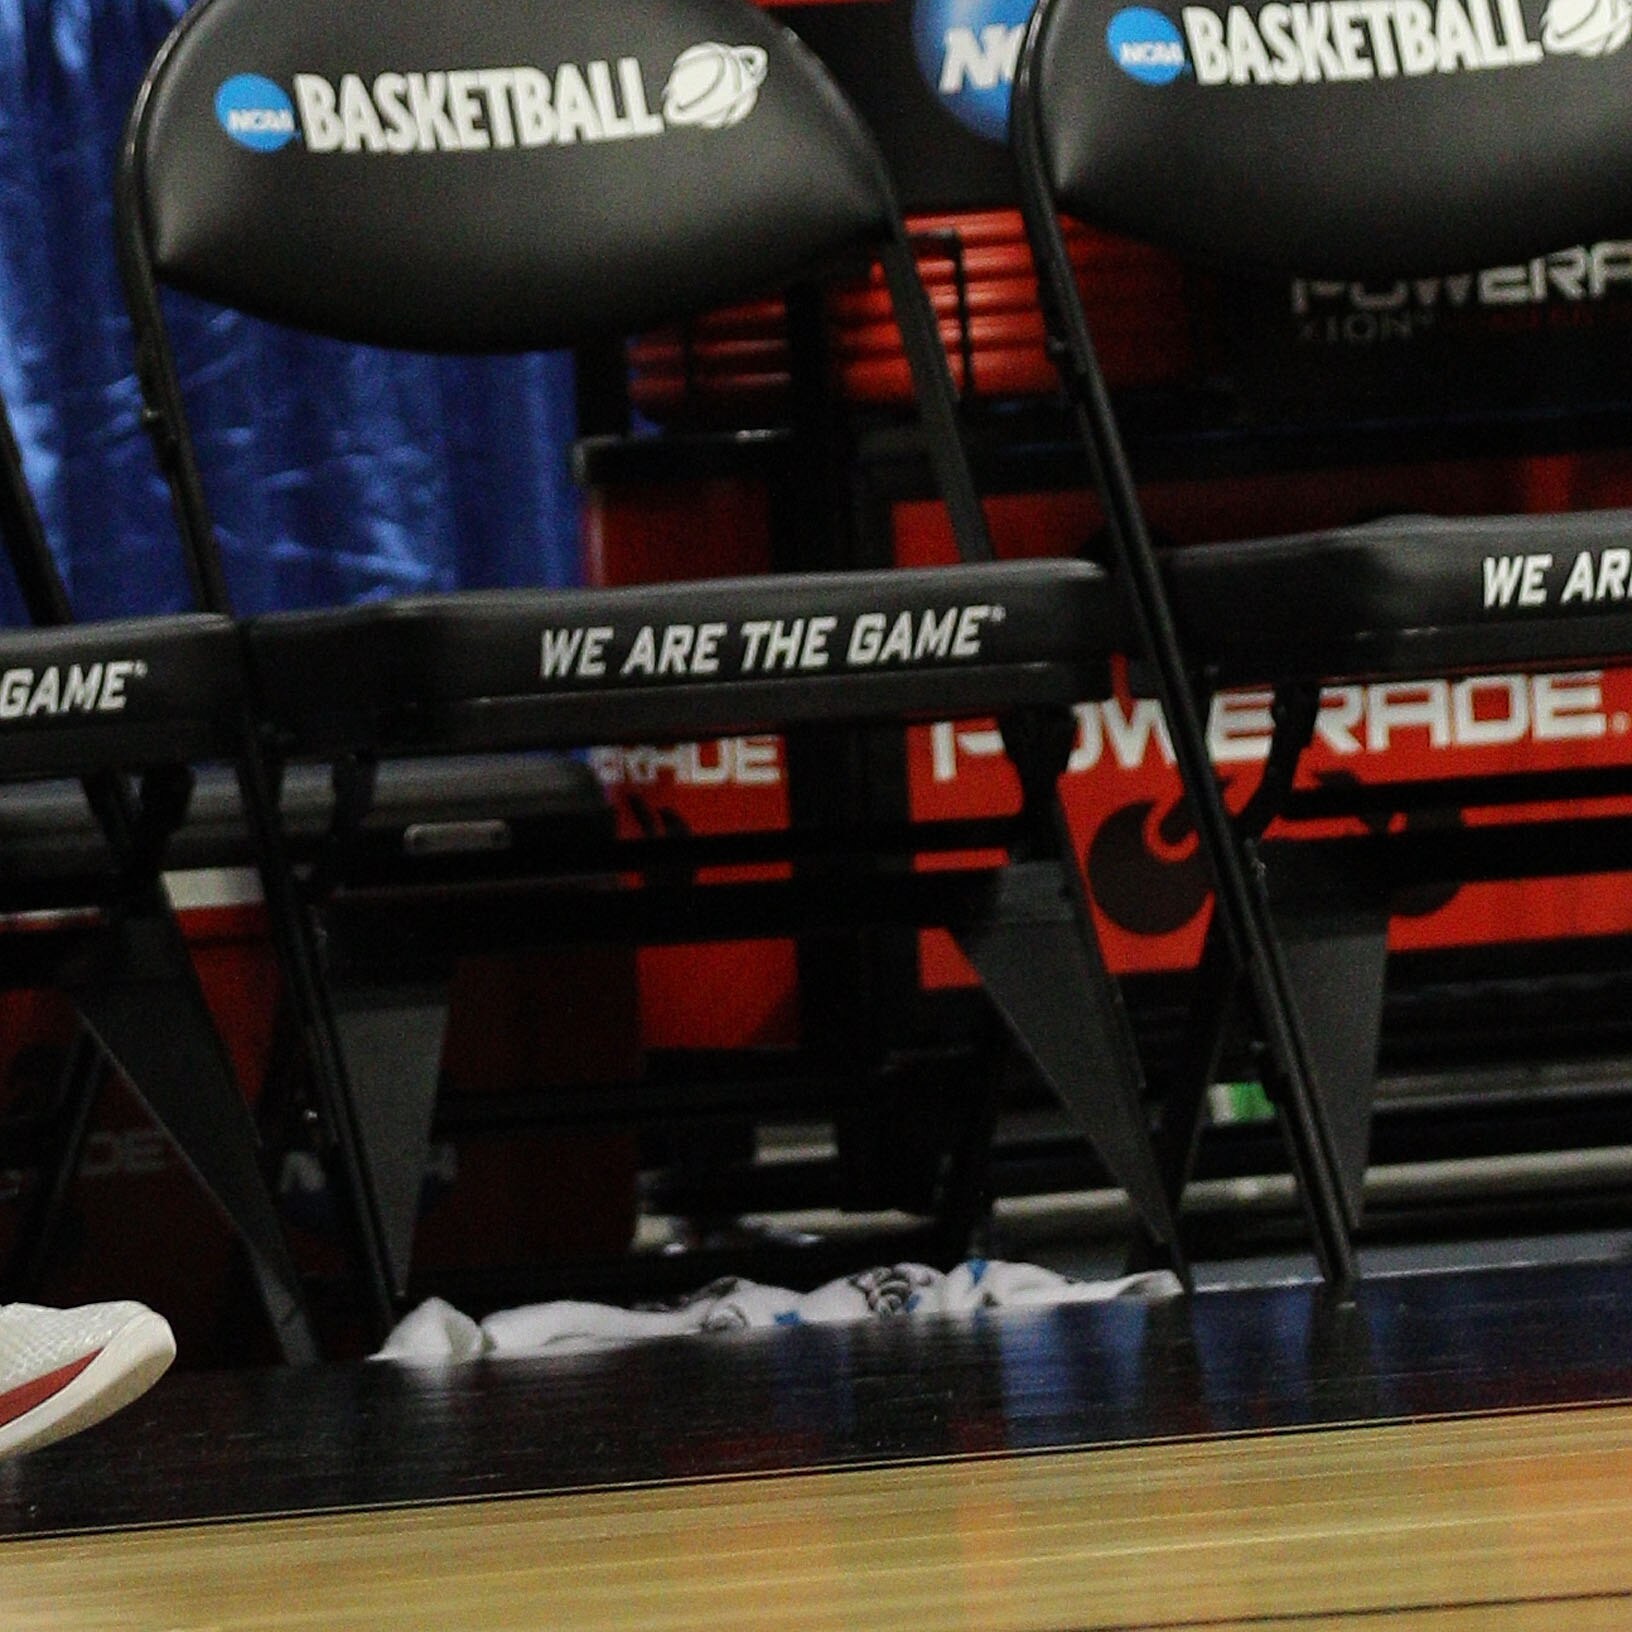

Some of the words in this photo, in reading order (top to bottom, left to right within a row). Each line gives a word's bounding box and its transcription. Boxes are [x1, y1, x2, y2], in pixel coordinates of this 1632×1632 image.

[1119, 40, 1184, 66] NCAA
[228, 109, 295, 134] NCAA
[293, 57, 665, 154] BASKETBALL
[1482, 552, 1553, 609] WE
[1560, 547, 1632, 605] AR
[540, 625, 614, 679] WE
[619, 622, 728, 678] ARE
[740, 616, 837, 671] THE
